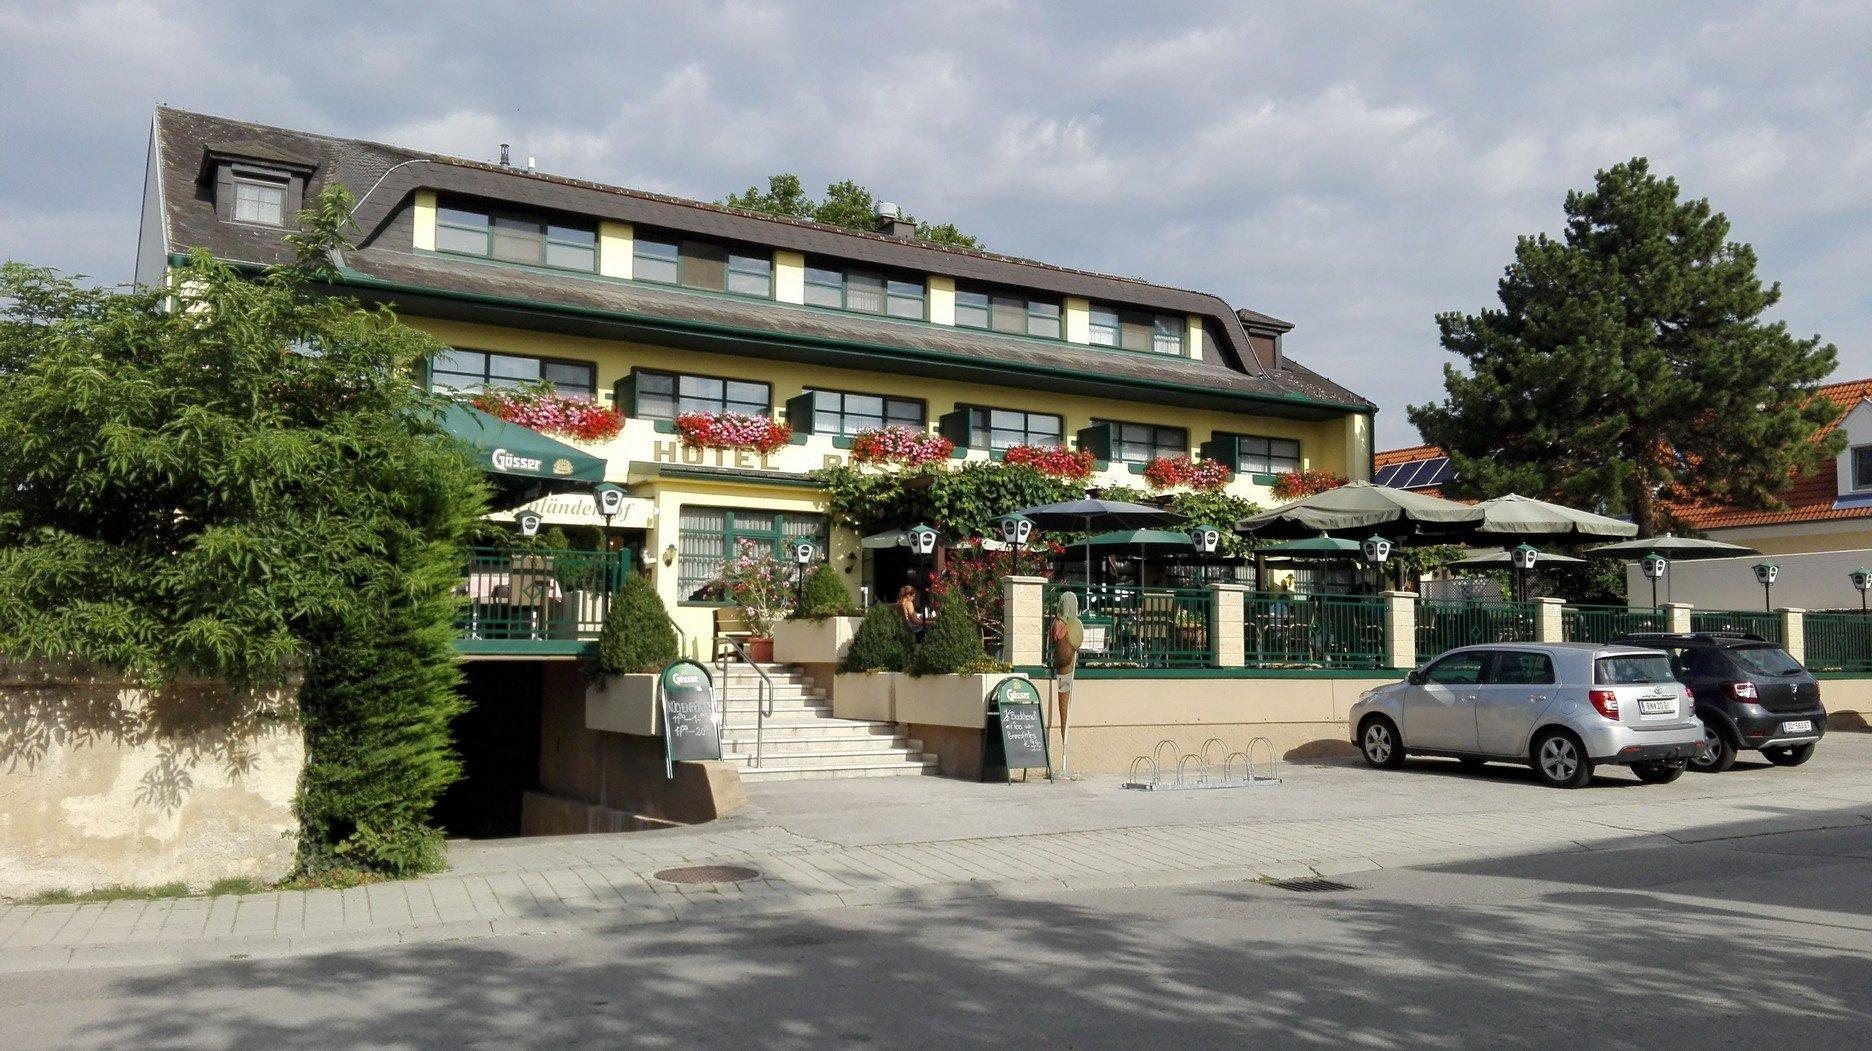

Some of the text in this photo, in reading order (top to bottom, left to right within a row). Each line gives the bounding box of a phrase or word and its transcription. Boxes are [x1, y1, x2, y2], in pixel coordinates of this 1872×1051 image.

[492, 449, 541, 471] Gösser
[654, 441, 779, 471] HOTEL
[1006, 688, 1030, 701] Gösser
